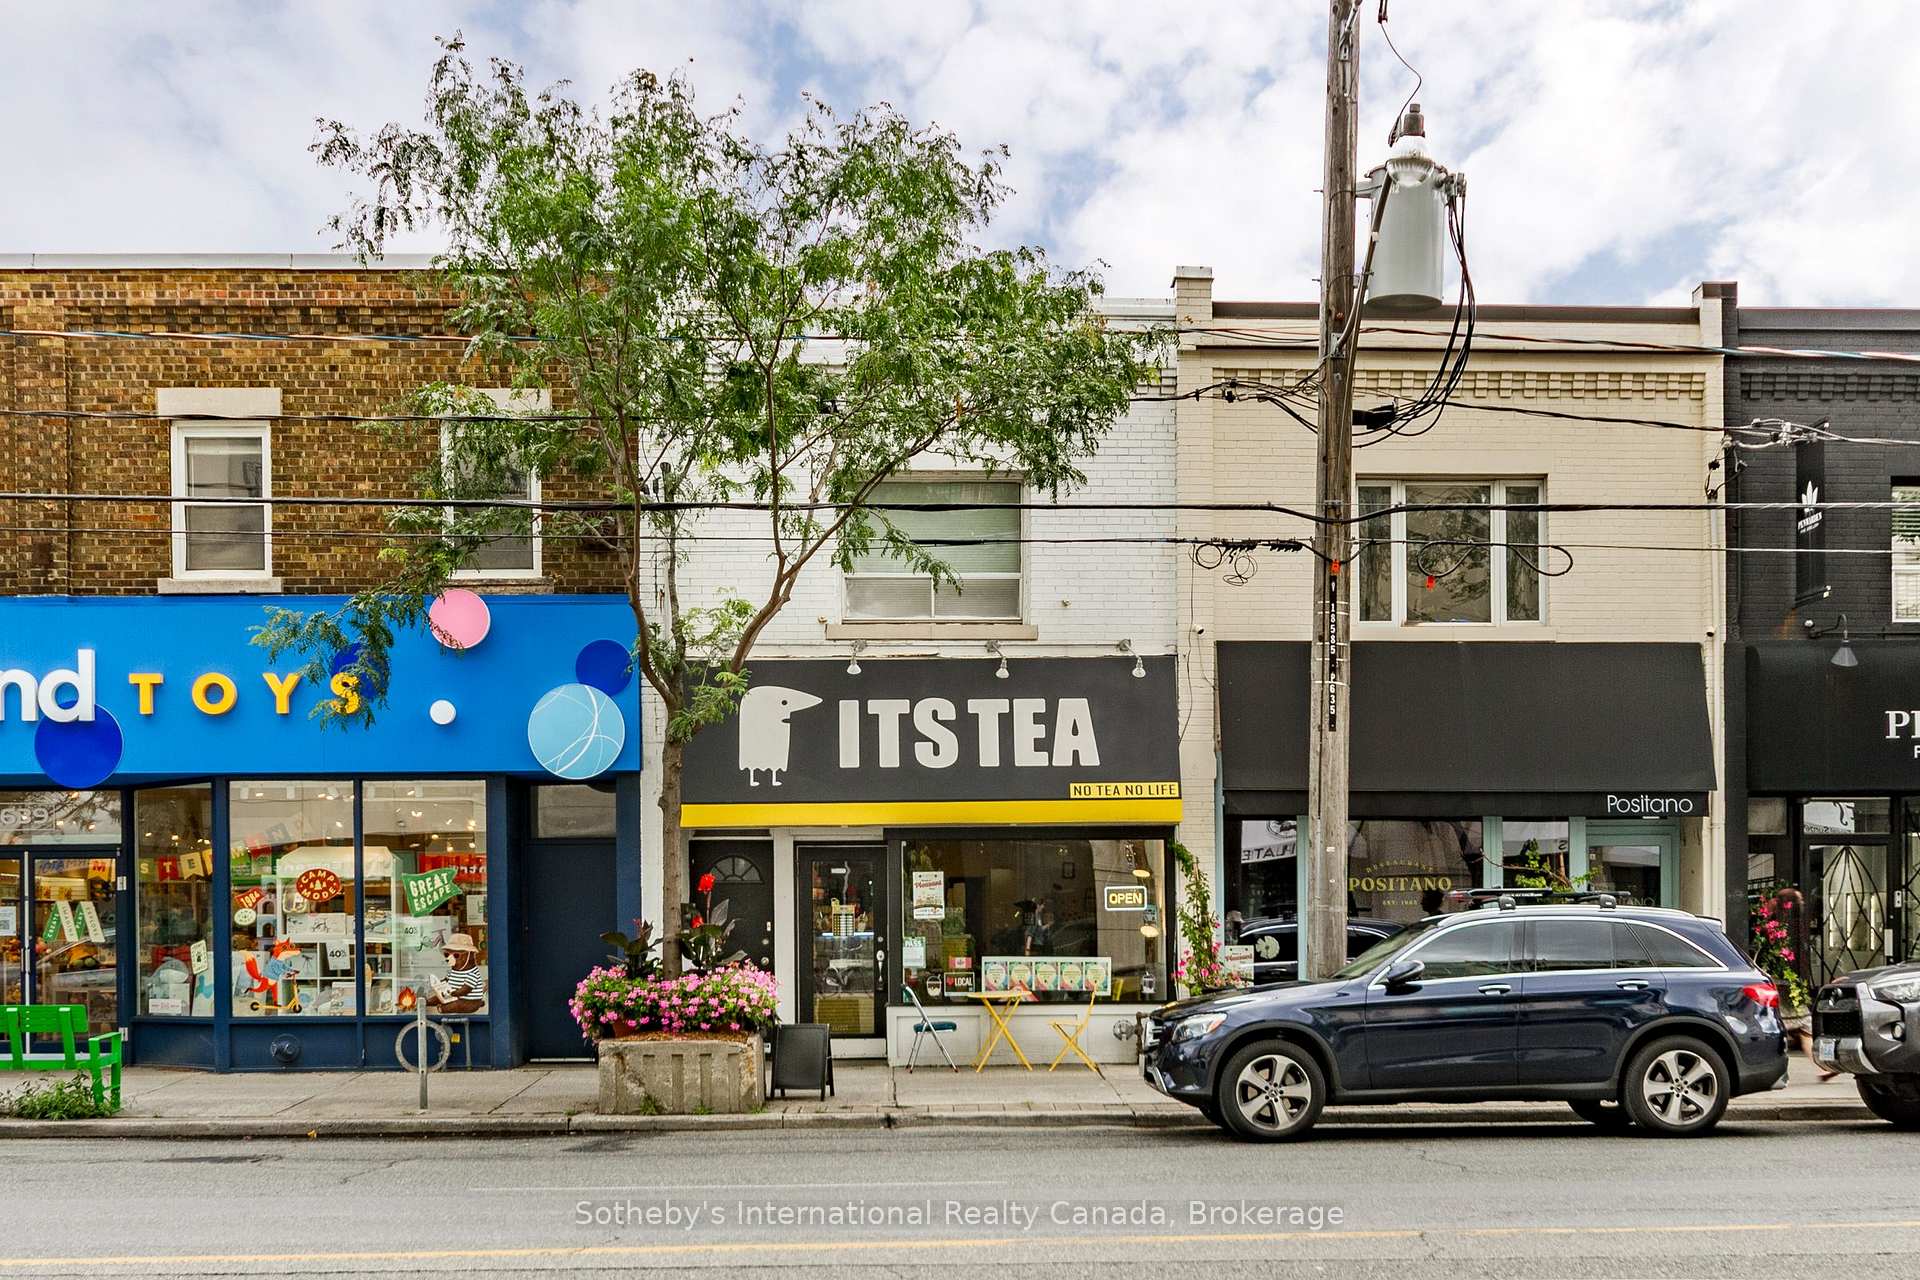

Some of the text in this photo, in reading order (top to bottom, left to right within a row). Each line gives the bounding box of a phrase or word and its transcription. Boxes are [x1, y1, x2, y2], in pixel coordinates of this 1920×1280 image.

[128, 672, 361, 715] TOYS
[1073, 783, 1176, 796] NO TEA NO LIFE
[1607, 794, 1694, 813] Positano
[301, 870, 335, 884] CAMP
[1348, 877, 1452, 892] POSITANO
[409, 872, 449, 898] GREAT
[240, 890, 261, 909] 1984
[301, 886, 336, 900] MODE
[413, 883, 452, 912] ESCAPE
[1109, 892, 1143, 905] OPEN
[954, 977, 973, 986] LOCAL
